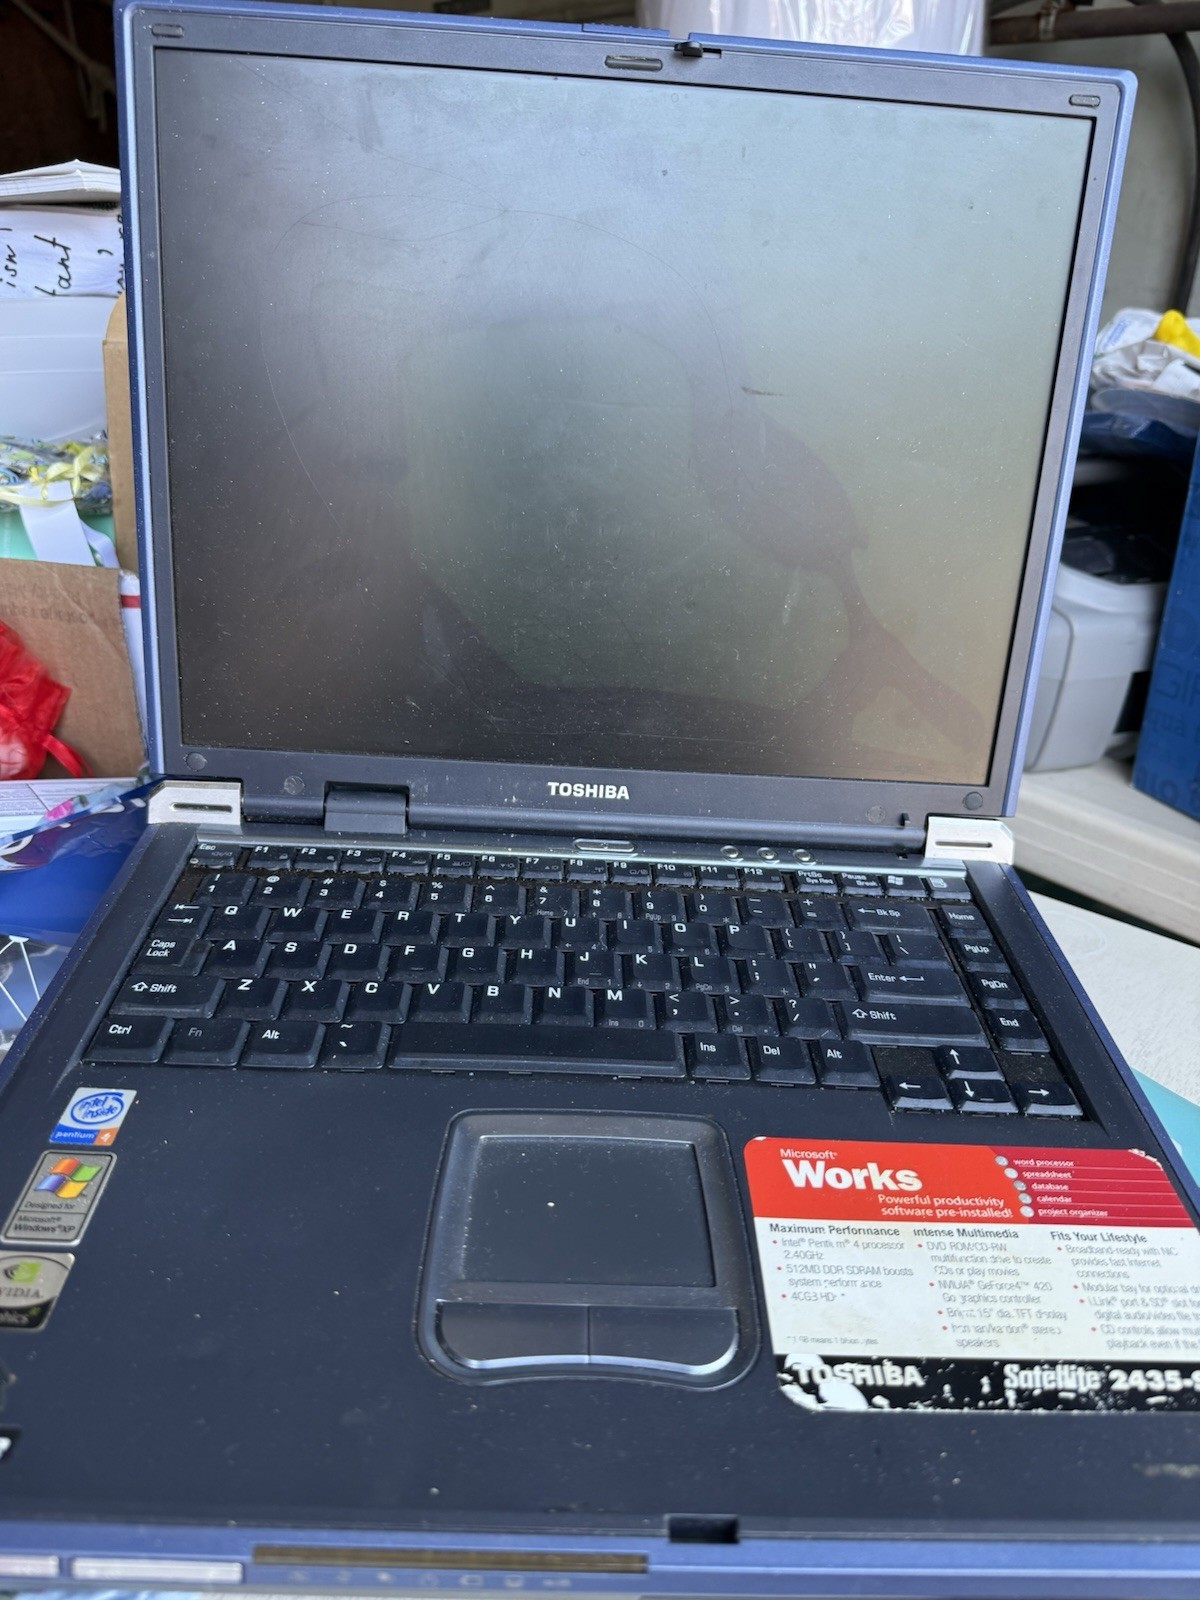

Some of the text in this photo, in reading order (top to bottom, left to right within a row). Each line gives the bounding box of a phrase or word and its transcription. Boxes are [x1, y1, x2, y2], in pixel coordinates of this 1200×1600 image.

[547, 781, 630, 800] TOSHIBA
[199, 843, 216, 851] Esc
[255, 846, 269, 854] F1
[481, 855, 495, 863] F6
[613, 861, 627, 869] F9
[657, 863, 676, 871] F10
[798, 870, 823, 878] PrtSc
[841, 872, 867, 881] Pause
[806, 877, 818, 885] Sys
[856, 879, 878, 887] Break
[208, 884, 216, 893] 1
[263, 886, 274, 894] 2
[319, 888, 329, 897] 3
[375, 890, 384, 899] 4
[430, 893, 439, 901] 5
[484, 894, 493, 903] 6
[539, 896, 547, 905] 7
[592, 899, 601, 907] 8
[646, 901, 655, 910] 9
[224, 905, 238, 917] Q
[283, 907, 302, 918] W
[699, 904, 708, 913] 0
[876, 908, 901, 918] Bk Sp
[341, 909, 353, 920] E
[397, 911, 410, 922] R
[455, 913, 467, 923] T
[948, 912, 975, 920] Home
[510, 915, 522, 925] Y
[565, 917, 576, 927] U
[622, 920, 628, 930] I
[674, 923, 687, 933] O
[729, 925, 740, 935] P
[151, 939, 176, 949] Caps
[222, 940, 237, 951] A
[284, 942, 298, 953] S
[344, 943, 357, 954] D
[964, 944, 990, 954] PgUp
[146, 949, 170, 957] Lock
[404, 945, 416, 956] F
[462, 947, 475, 958] G
[520, 949, 533, 960] H
[579, 952, 590, 962] J
[635, 954, 648, 965] K
[694, 957, 705, 968] L
[868, 973, 897, 983] Enter
[150, 984, 178, 993] Shift
[237, 979, 253, 991] Z
[301, 980, 317, 992] X
[364, 982, 378, 994] C
[981, 979, 1008, 989] PgDn
[427, 984, 441, 995] V
[487, 986, 499, 997] B
[548, 987, 561, 999] N
[607, 990, 623, 1001] M
[869, 1011, 897, 1021] Shift
[999, 1017, 1020, 1027] End
[108, 1025, 133, 1035] Ctrl
[188, 1028, 203, 1037] Fn
[262, 1029, 280, 1040] Alt
[700, 1042, 717, 1052] Ins
[763, 1045, 781, 1056] Del
[826, 1049, 843, 1059] Alt
[55, 1130, 95, 1140] pentium
[1036, 1160, 1075, 1168] processor
[781, 1159, 923, 1192] Works
[1031, 1183, 1070, 1191] database
[878, 1194, 1005, 1208] Powerful productivity
[1036, 1195, 1073, 1203] calendar
[24, 1200, 76, 1211] Designed for
[881, 1205, 1014, 1219] software pre-installed!
[60, 1225, 76, 1233] XP
[769, 1223, 901, 1237] Maximum Performance
[956, 1228, 1020, 1239] Multimedia
[1050, 1231, 1148, 1244] Fits Your Lifestyle
[793, 1363, 926, 1388] TOSHIBA
[1003, 1363, 1101, 1392] Satellite
